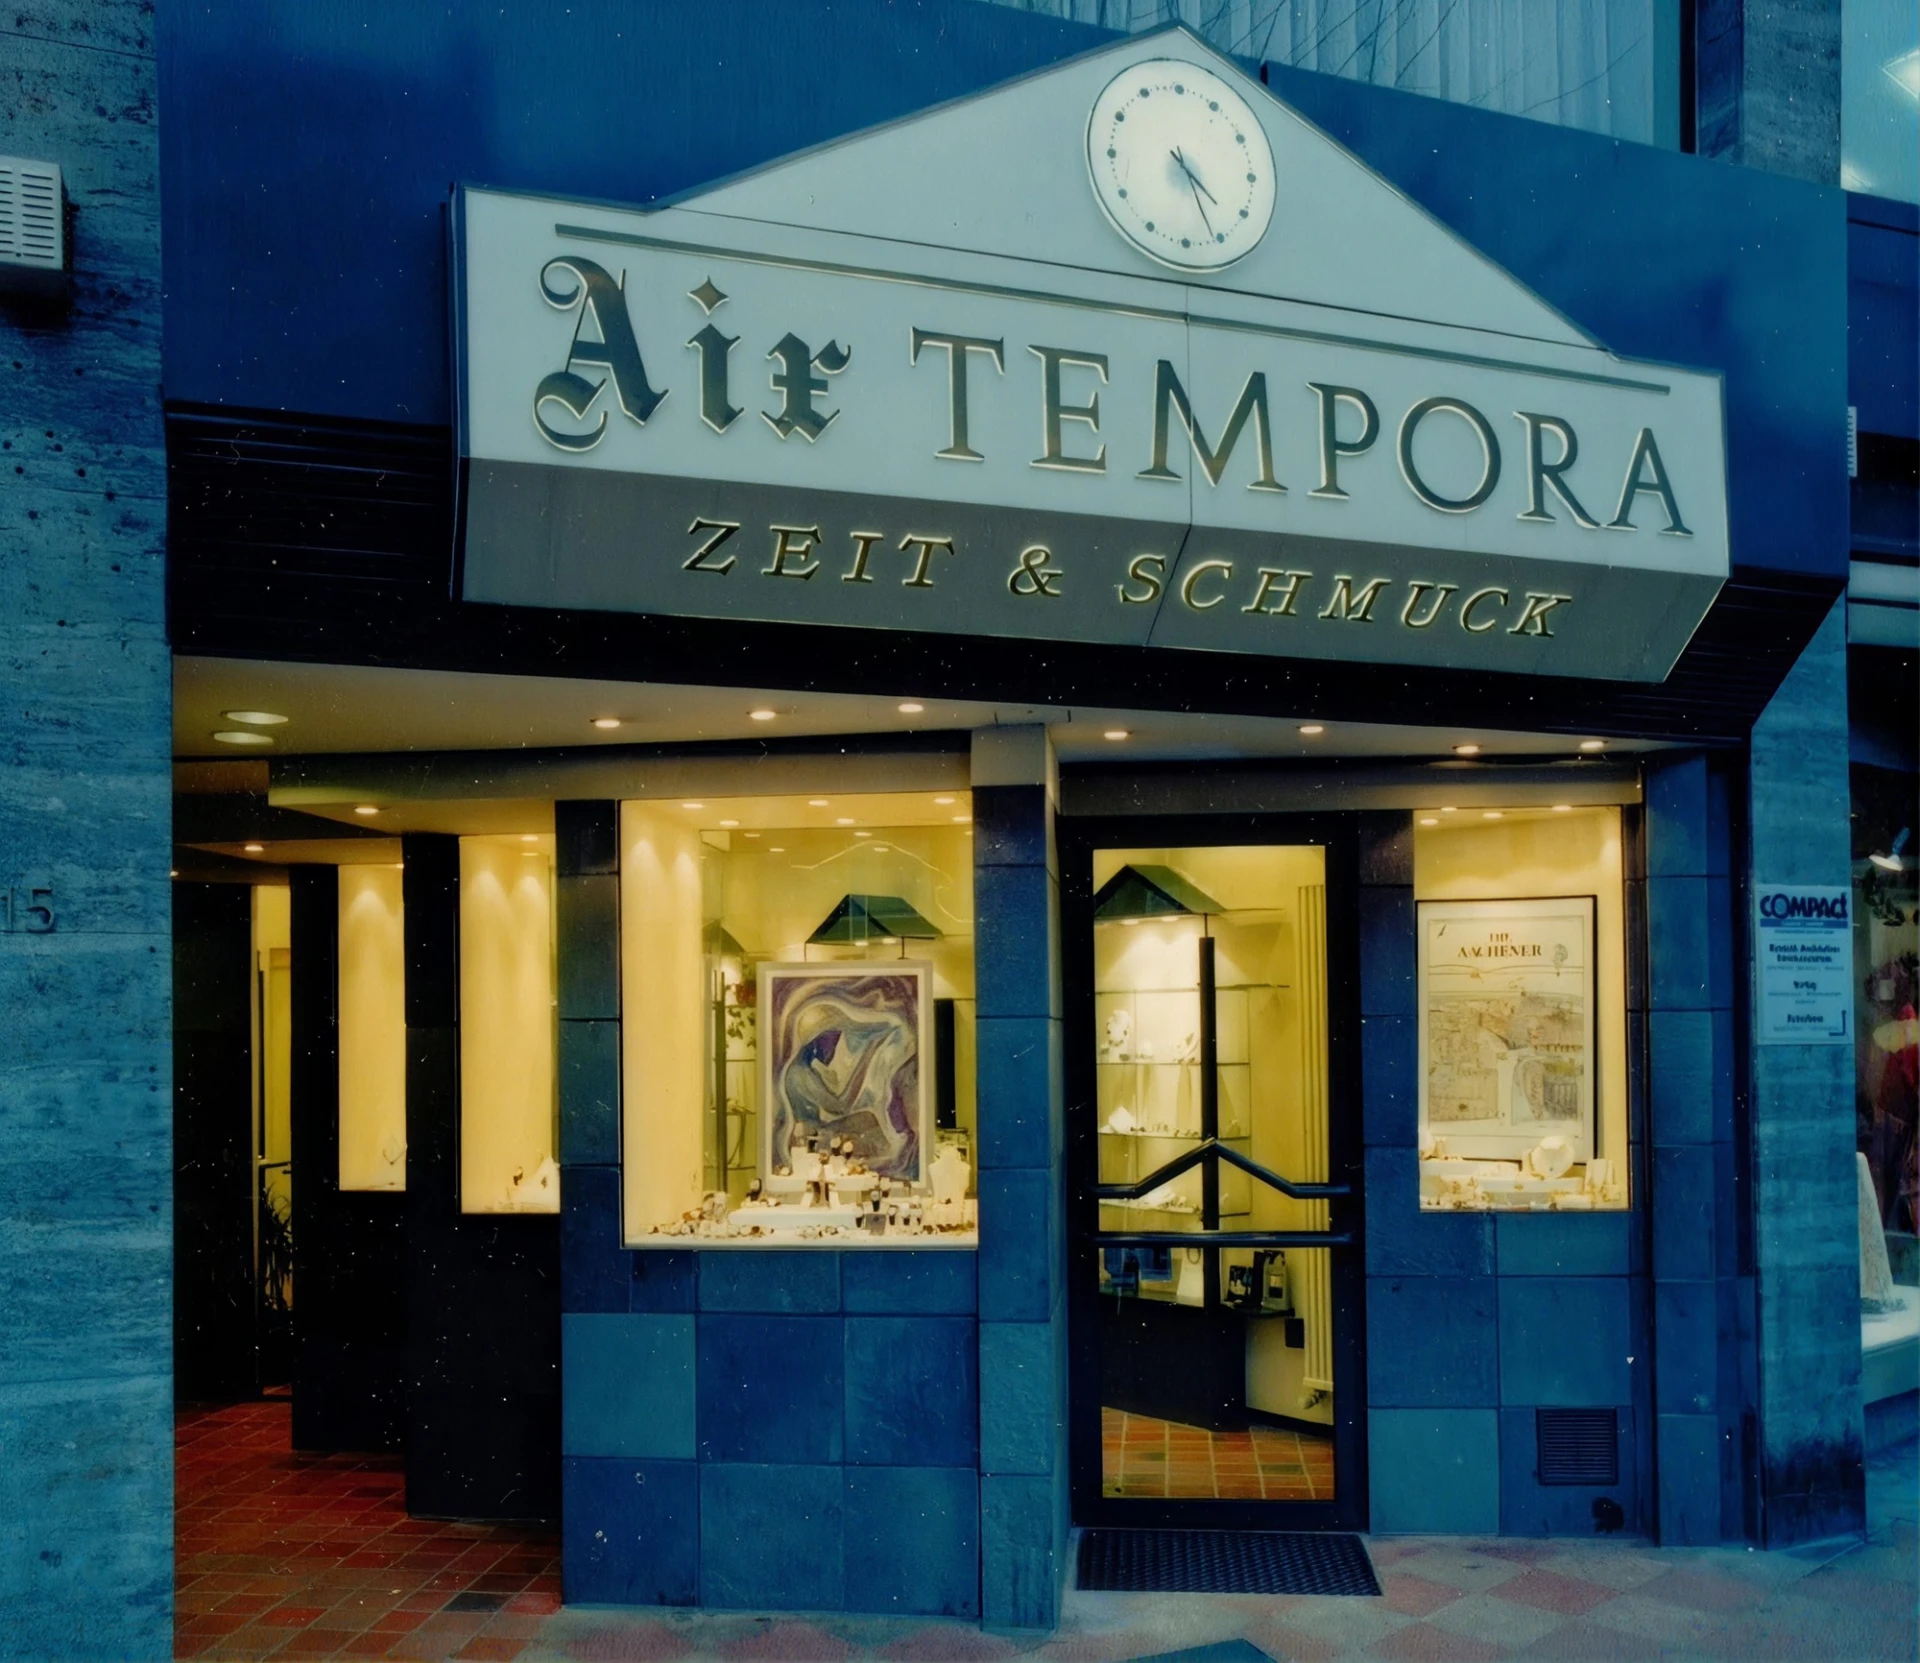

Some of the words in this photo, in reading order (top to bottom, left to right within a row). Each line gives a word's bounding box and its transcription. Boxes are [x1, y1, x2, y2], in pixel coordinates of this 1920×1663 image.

[534, 255, 851, 451] Aix
[911, 326, 1693, 536] TEMPORA
[682, 517, 955, 587] ZEIT
[1007, 545, 1064, 597] &
[1117, 555, 1572, 637] SCHMUCK
[0, 888, 56, 933] 15
